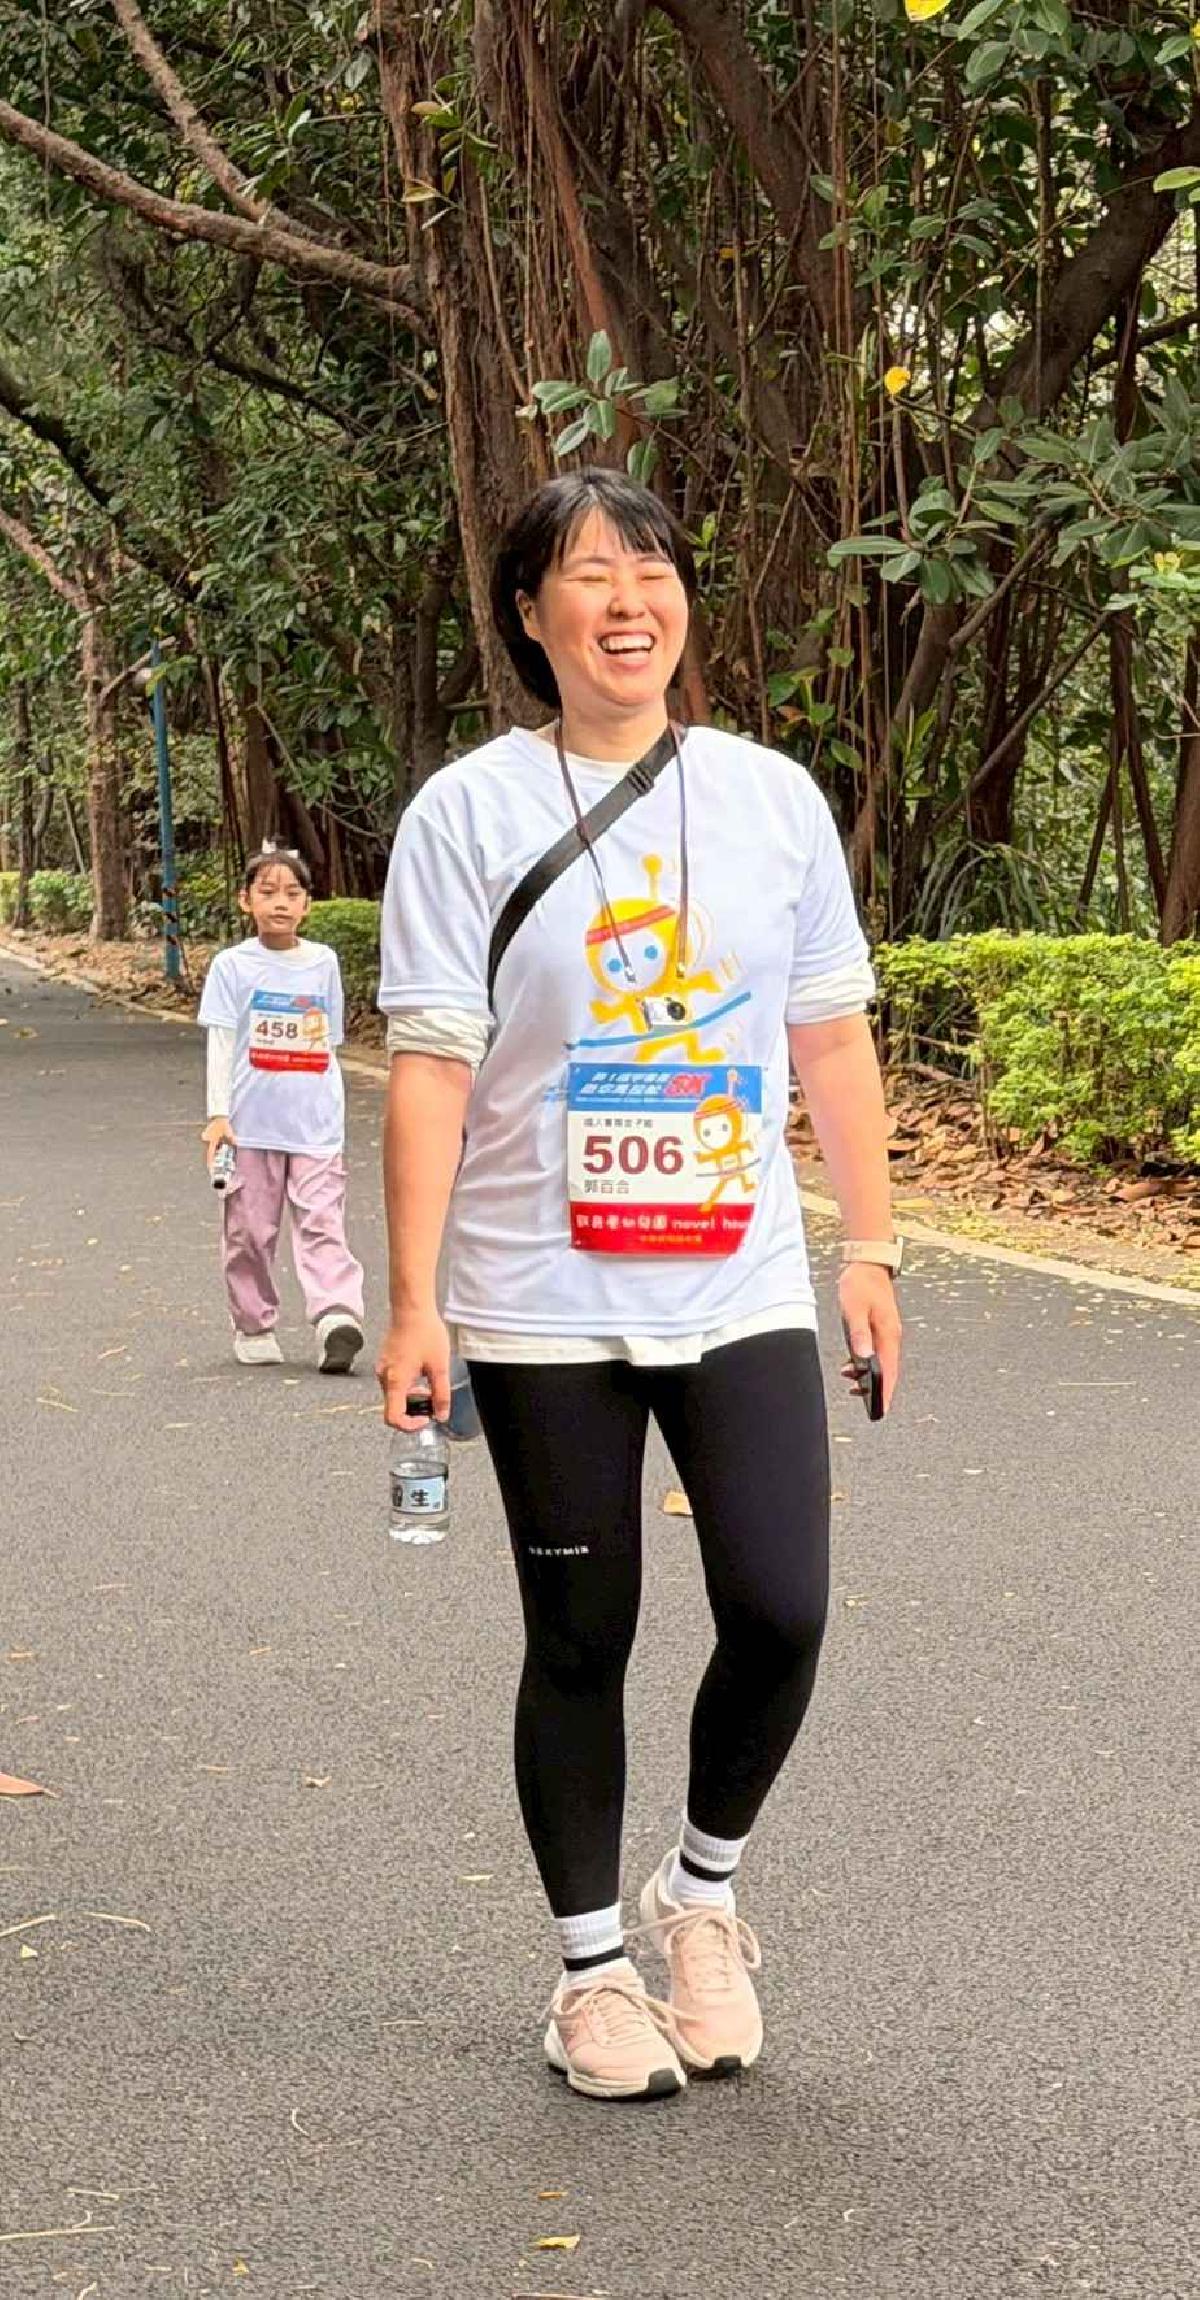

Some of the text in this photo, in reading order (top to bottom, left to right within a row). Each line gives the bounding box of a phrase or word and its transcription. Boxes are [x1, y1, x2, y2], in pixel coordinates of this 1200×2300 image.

[256, 1020, 298, 1038] 458
[583, 1135, 684, 1175] 506
[672, 1215, 716, 1230] novel
